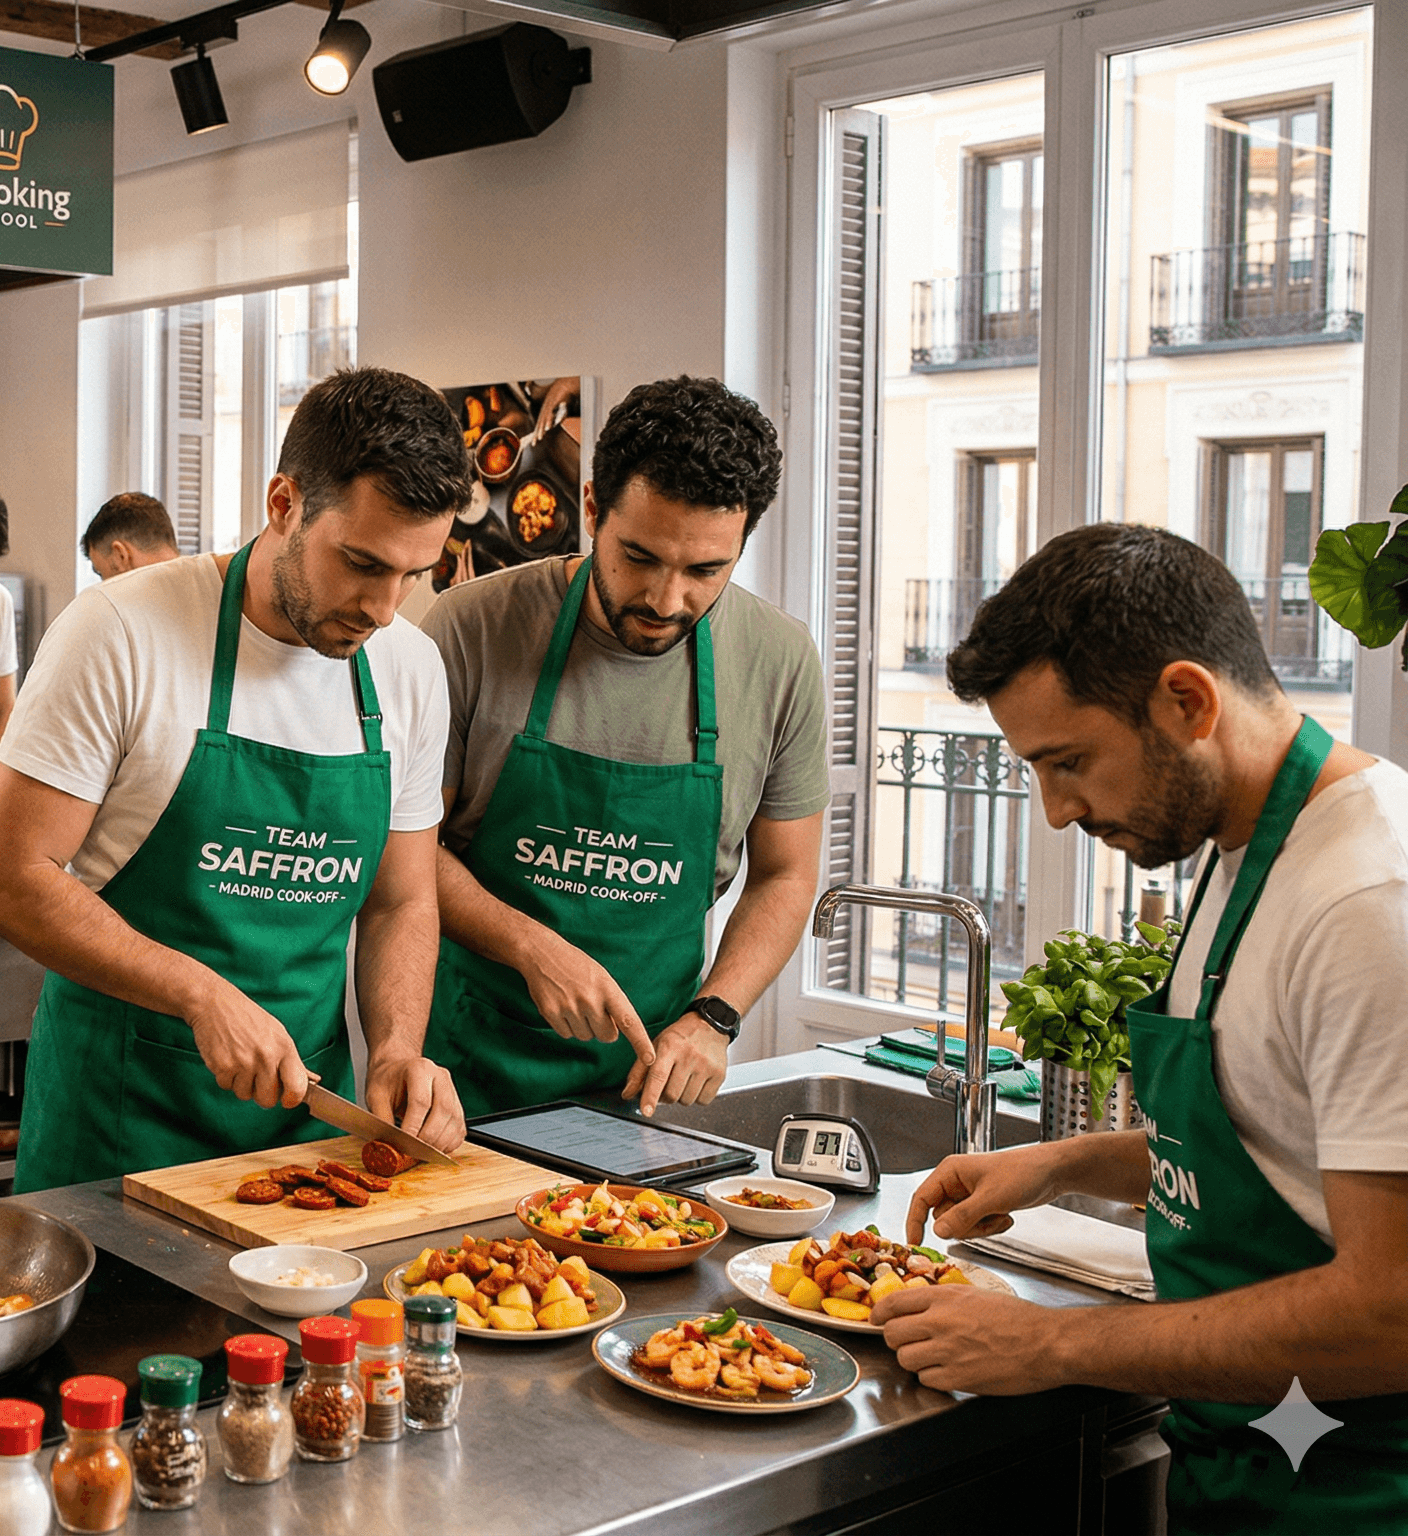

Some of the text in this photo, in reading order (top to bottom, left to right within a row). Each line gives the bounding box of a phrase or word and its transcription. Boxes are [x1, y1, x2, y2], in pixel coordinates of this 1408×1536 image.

[265, 825, 328, 850] TEAM
[573, 826, 638, 850] TEAM
[197, 841, 363, 884] SAFFRON
[514, 837, 684, 885] SAFFRON
[218, 881, 340, 904] MADRID COOK-OFF
[533, 873, 659, 904] MADRID COOK-OFF
